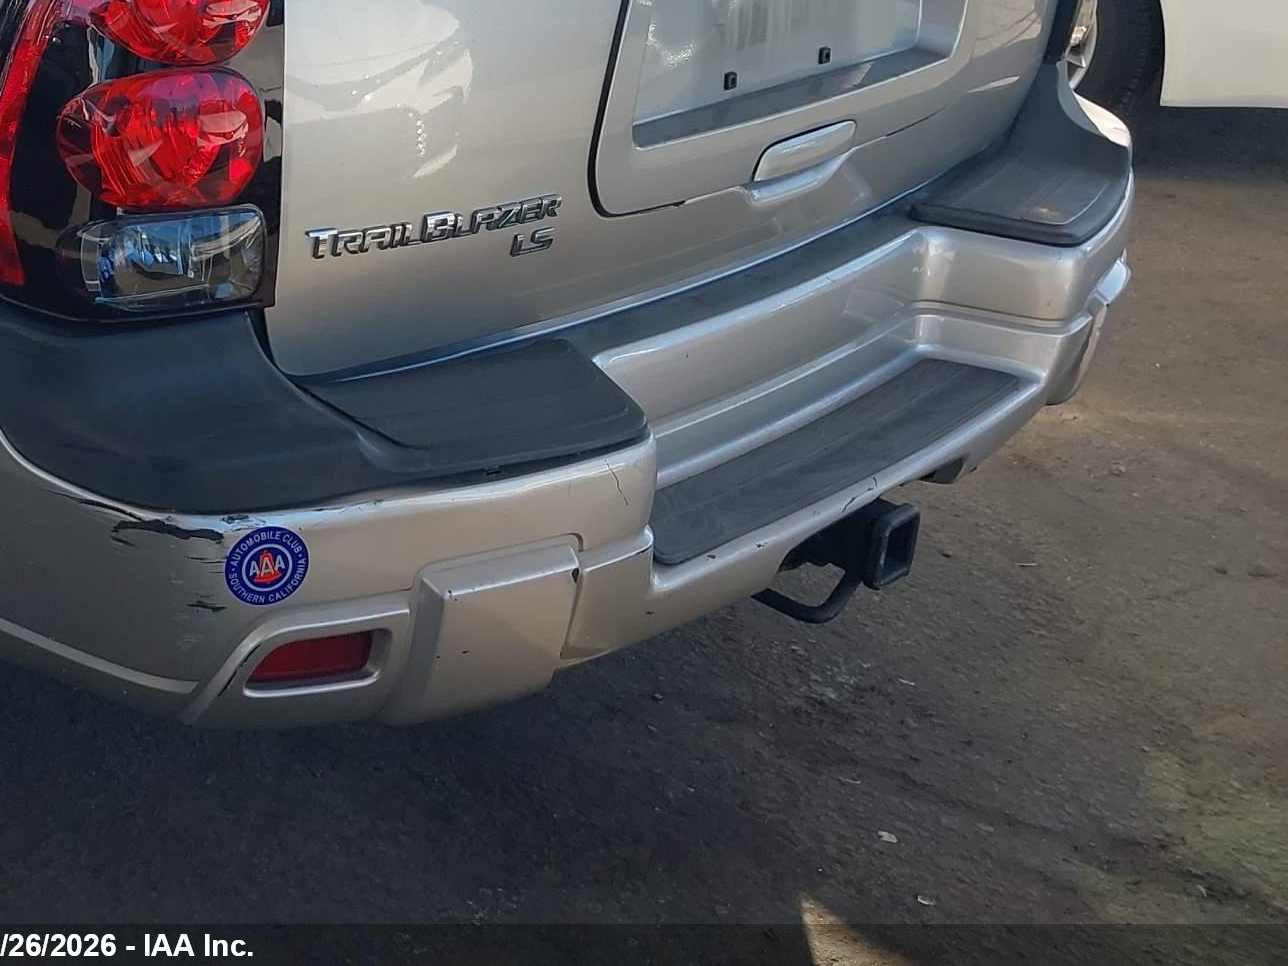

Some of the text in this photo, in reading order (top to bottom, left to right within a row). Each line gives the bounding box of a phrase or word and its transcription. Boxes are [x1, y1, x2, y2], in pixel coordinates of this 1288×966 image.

[509, 227, 556, 257] LS
[232, 531, 303, 566] AUTOMOBILE CLUB
[229, 557, 306, 603] SOUTHERN CALIFORNIA
[249, 555, 285, 576] AAA
